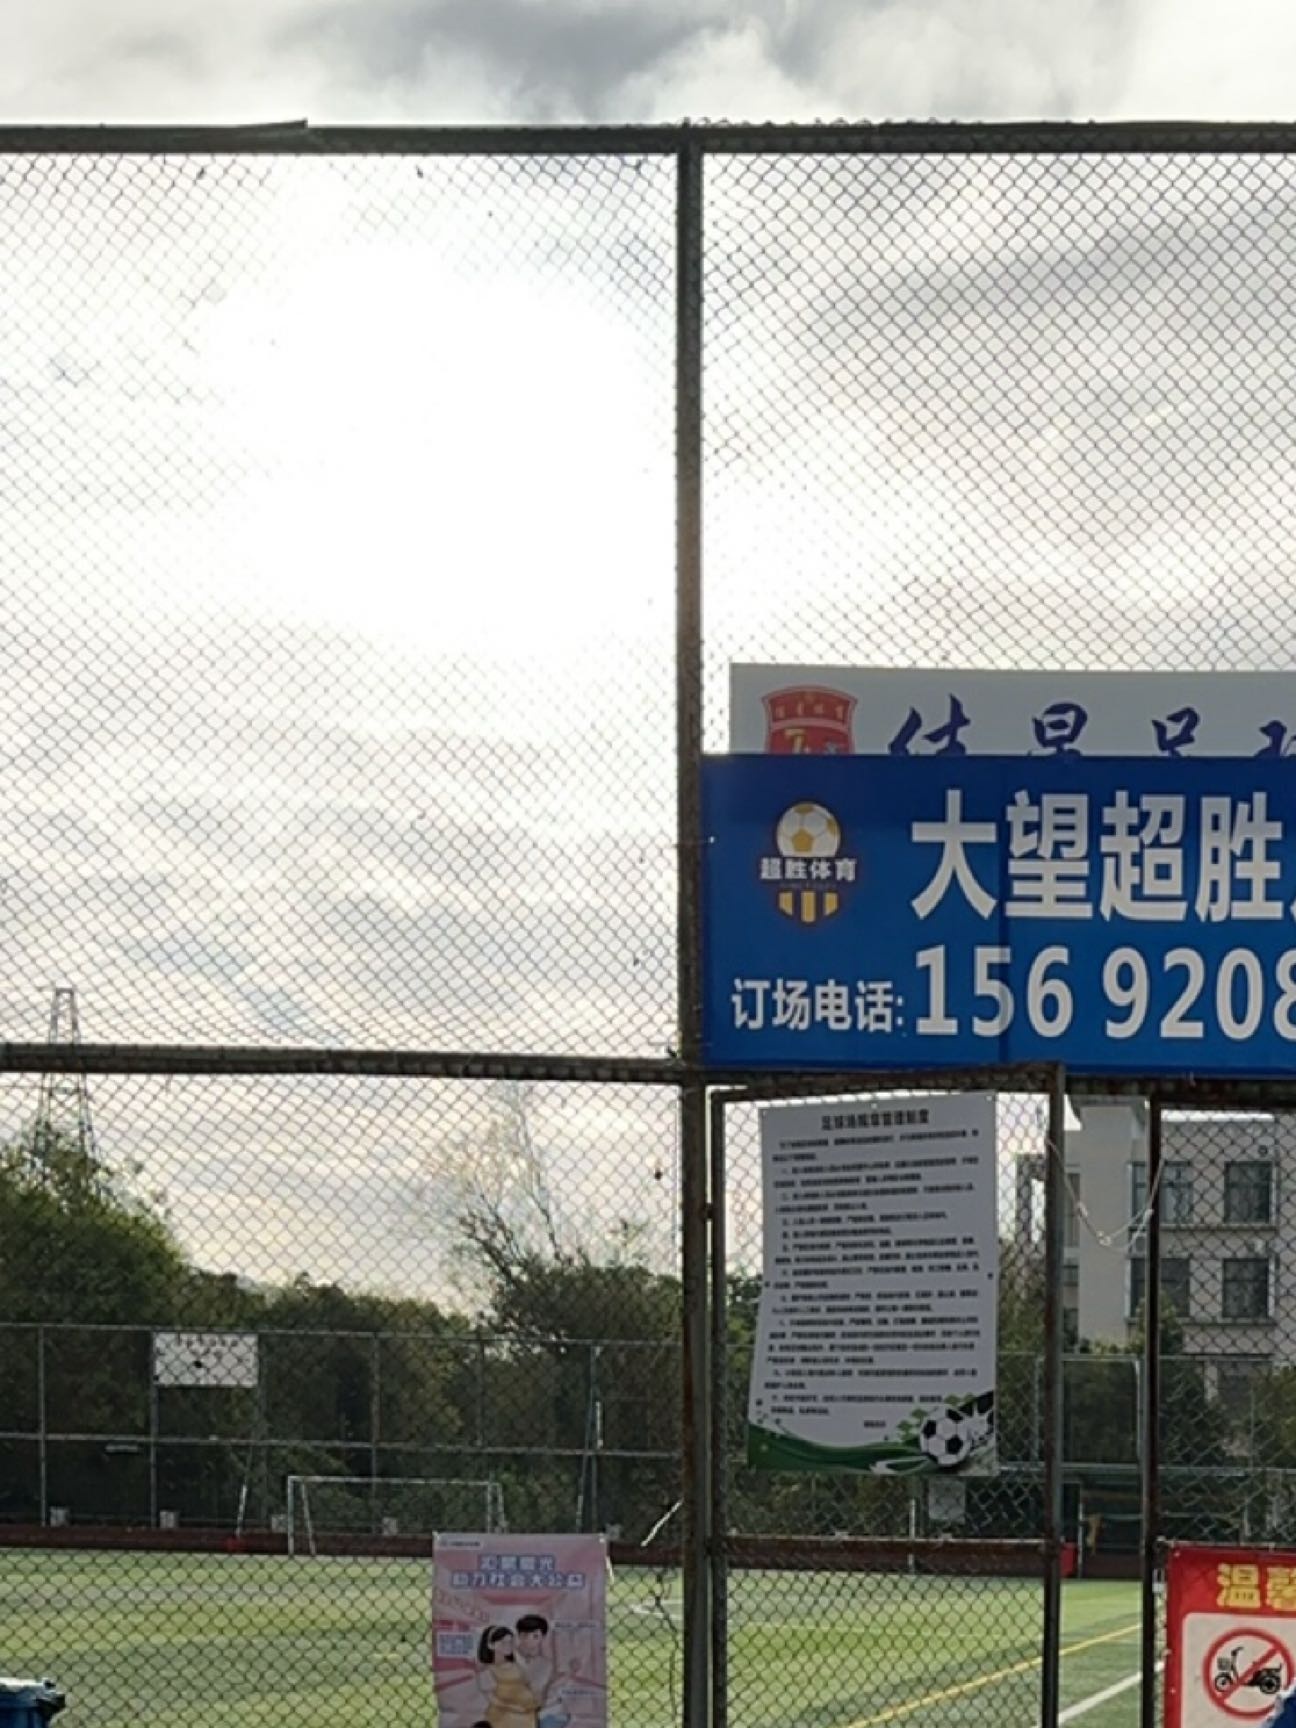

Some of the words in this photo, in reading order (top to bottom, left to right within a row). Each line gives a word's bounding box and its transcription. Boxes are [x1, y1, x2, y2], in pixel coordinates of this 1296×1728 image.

[760, 857, 857, 881] 超胜体育
[915, 945, 1072, 1037] 156
